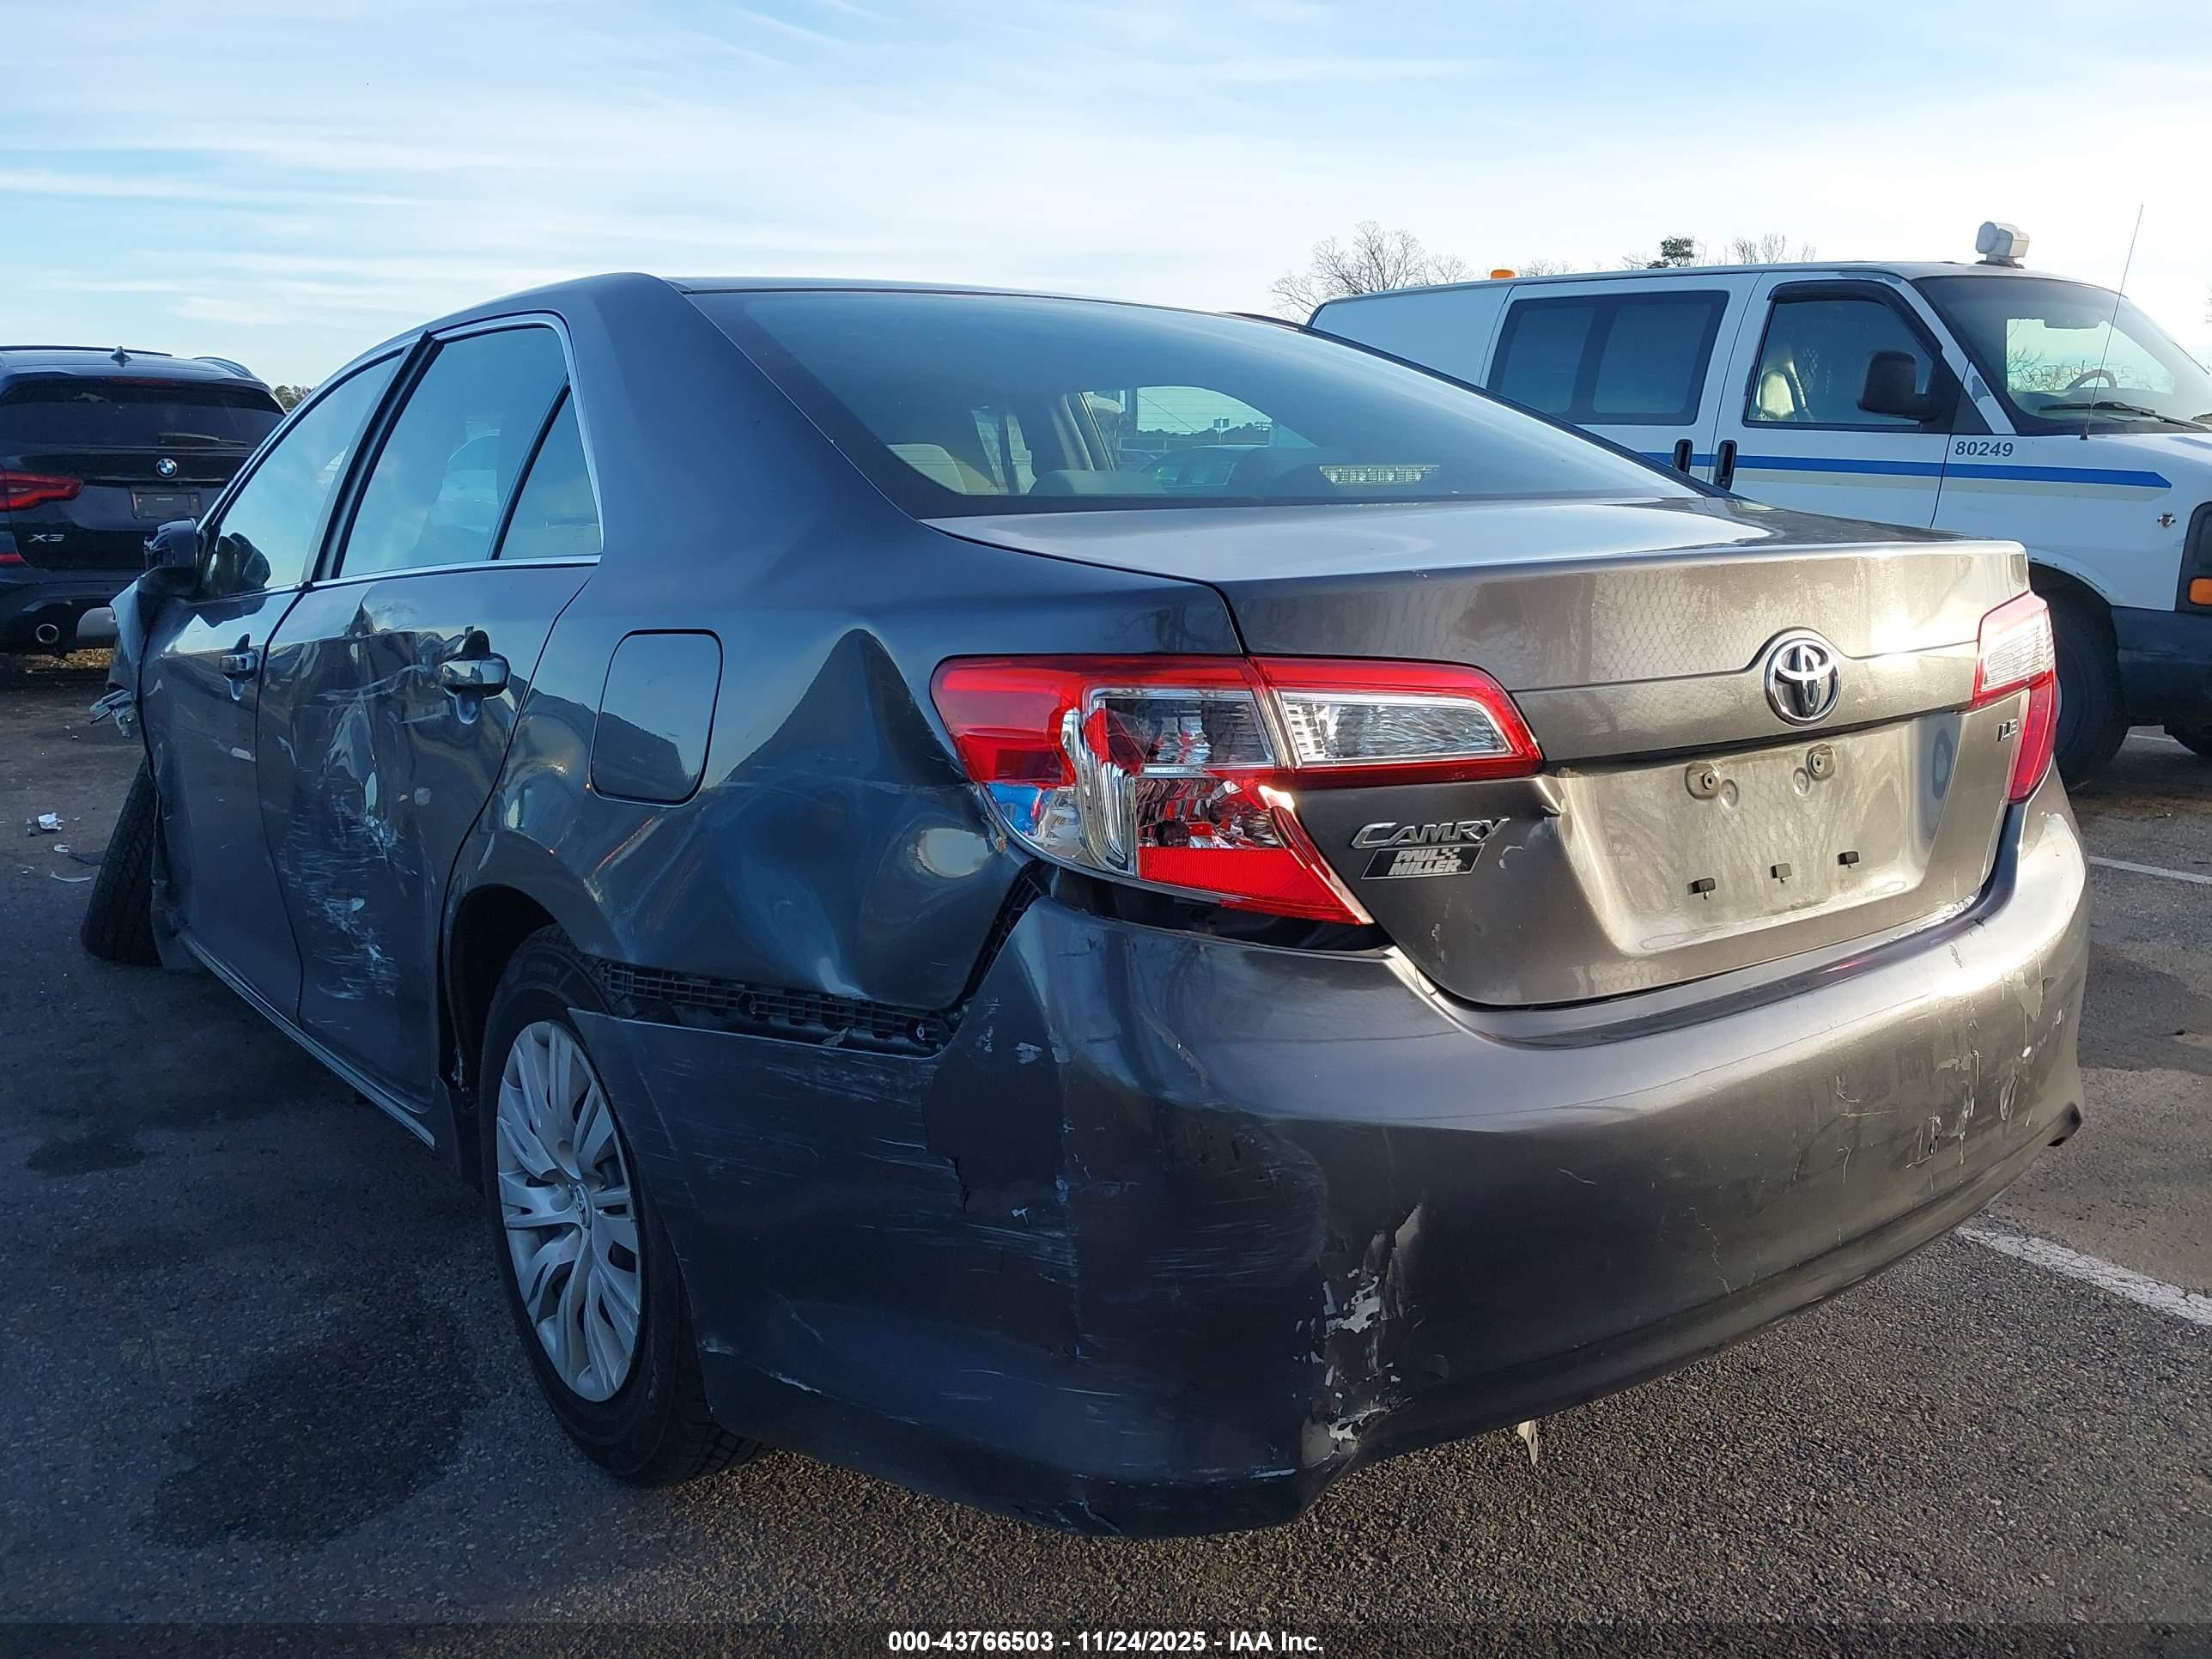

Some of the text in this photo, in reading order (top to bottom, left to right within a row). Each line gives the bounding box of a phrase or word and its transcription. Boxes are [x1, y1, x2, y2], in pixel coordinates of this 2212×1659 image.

[1955, 441, 2014, 458] 80249
[27, 532, 65, 543] X3
[1351, 817, 1511, 849] CAMRY
[1395, 848, 1441, 863] PAUL
[1387, 859, 1463, 877] MILLER
